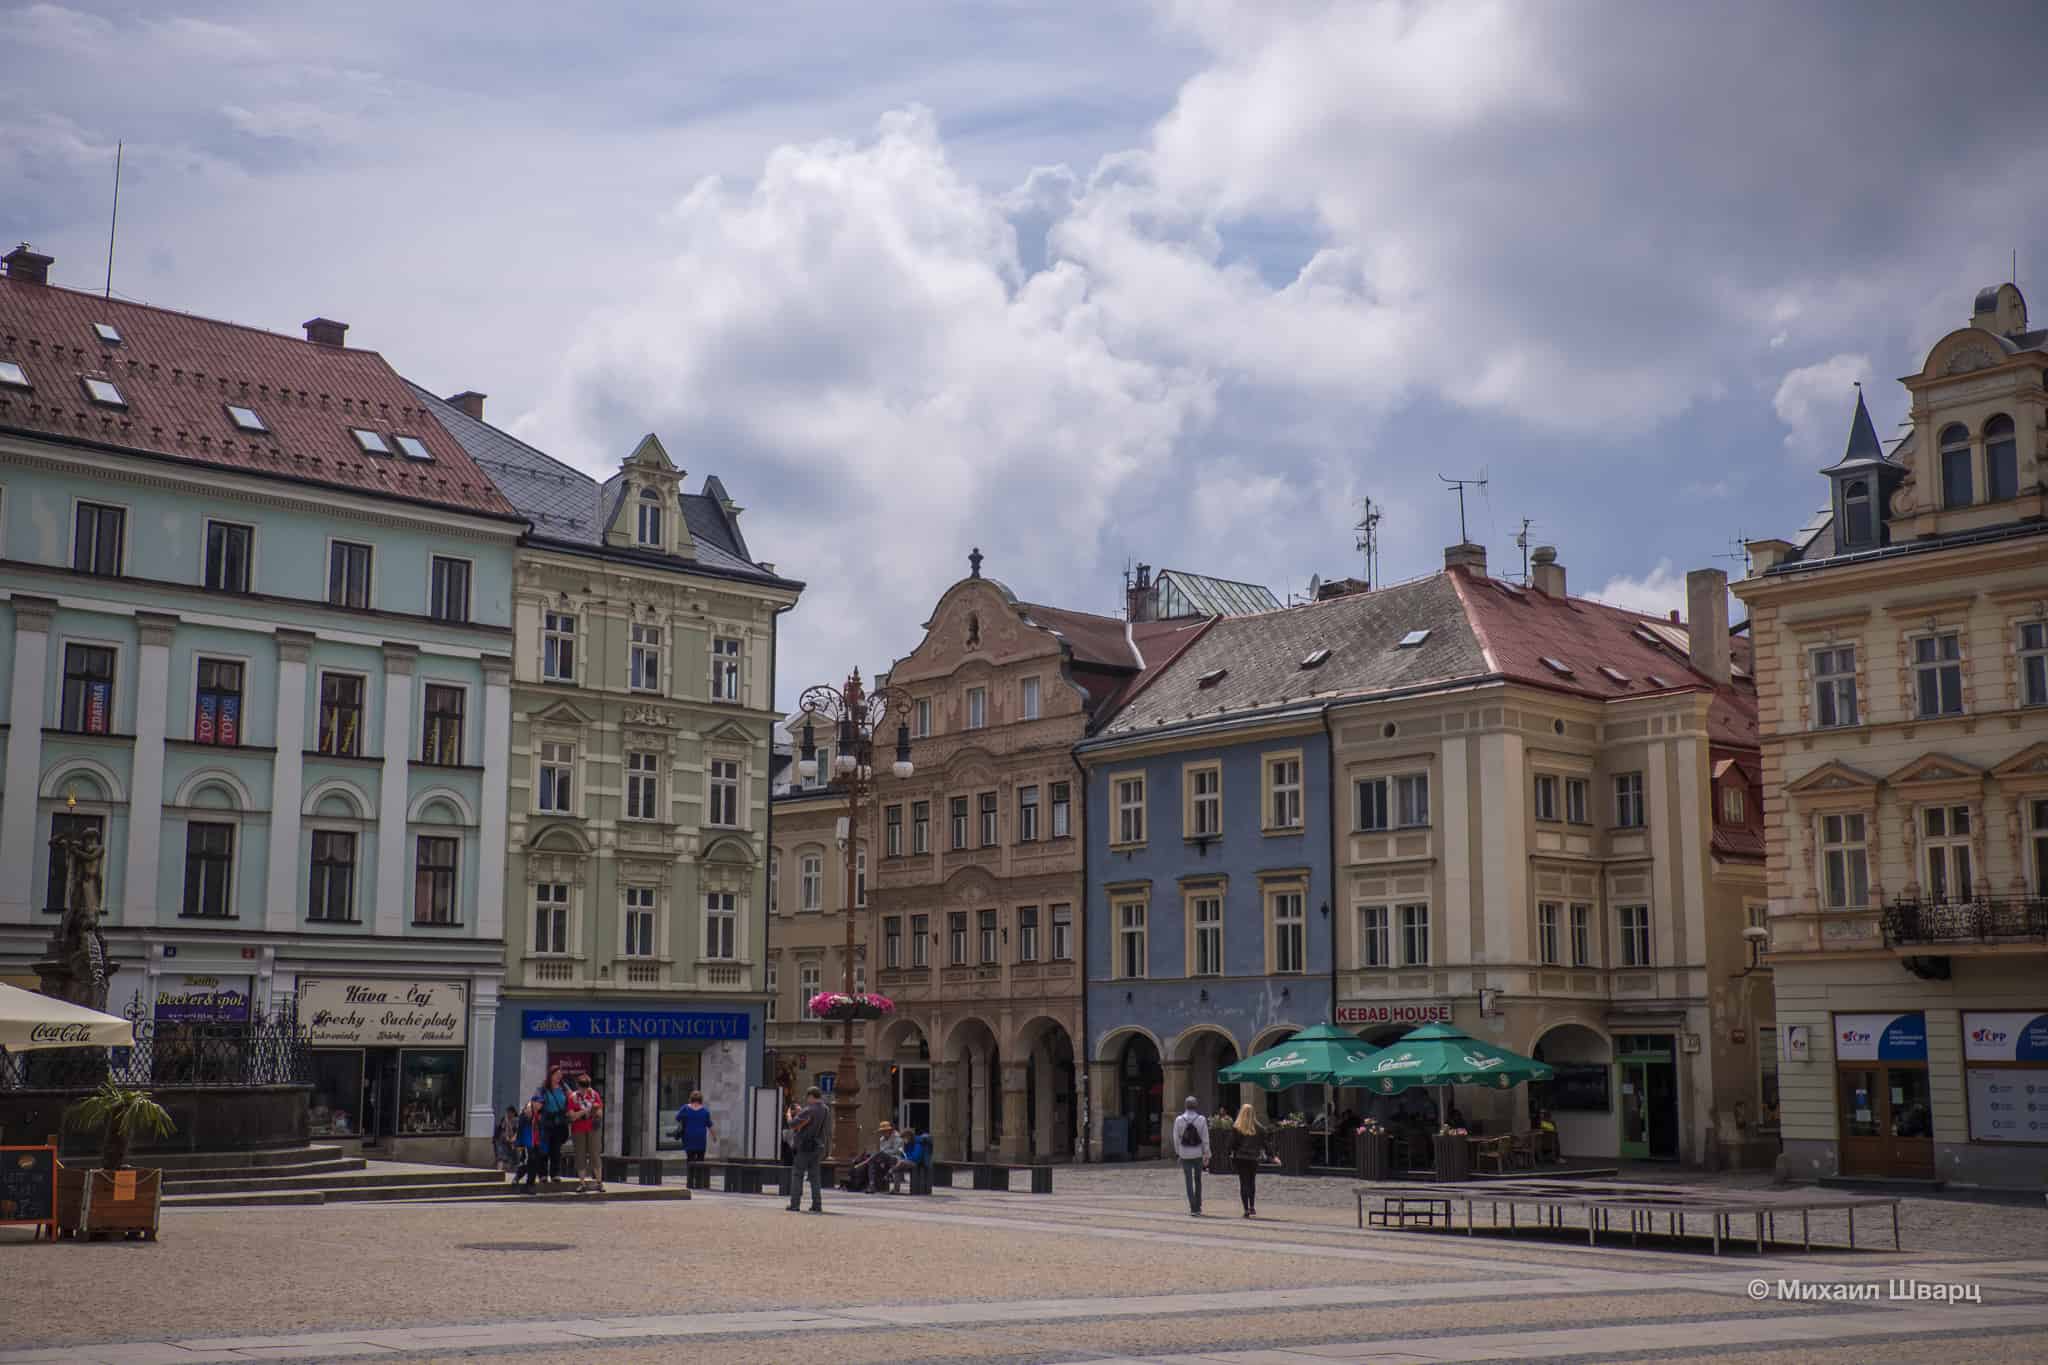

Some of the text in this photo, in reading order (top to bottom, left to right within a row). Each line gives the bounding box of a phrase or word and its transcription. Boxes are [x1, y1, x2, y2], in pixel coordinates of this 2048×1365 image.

[91, 684, 105, 731] ZDARMA
[346, 984, 434, 1007] Káva Čaj
[381, 1010, 424, 1027] Suché
[423, 1011, 457, 1030] plody
[1337, 1007, 1449, 1021] KEBAB HOUSE
[589, 1017, 737, 1035] KLENOTNICTVÍ
